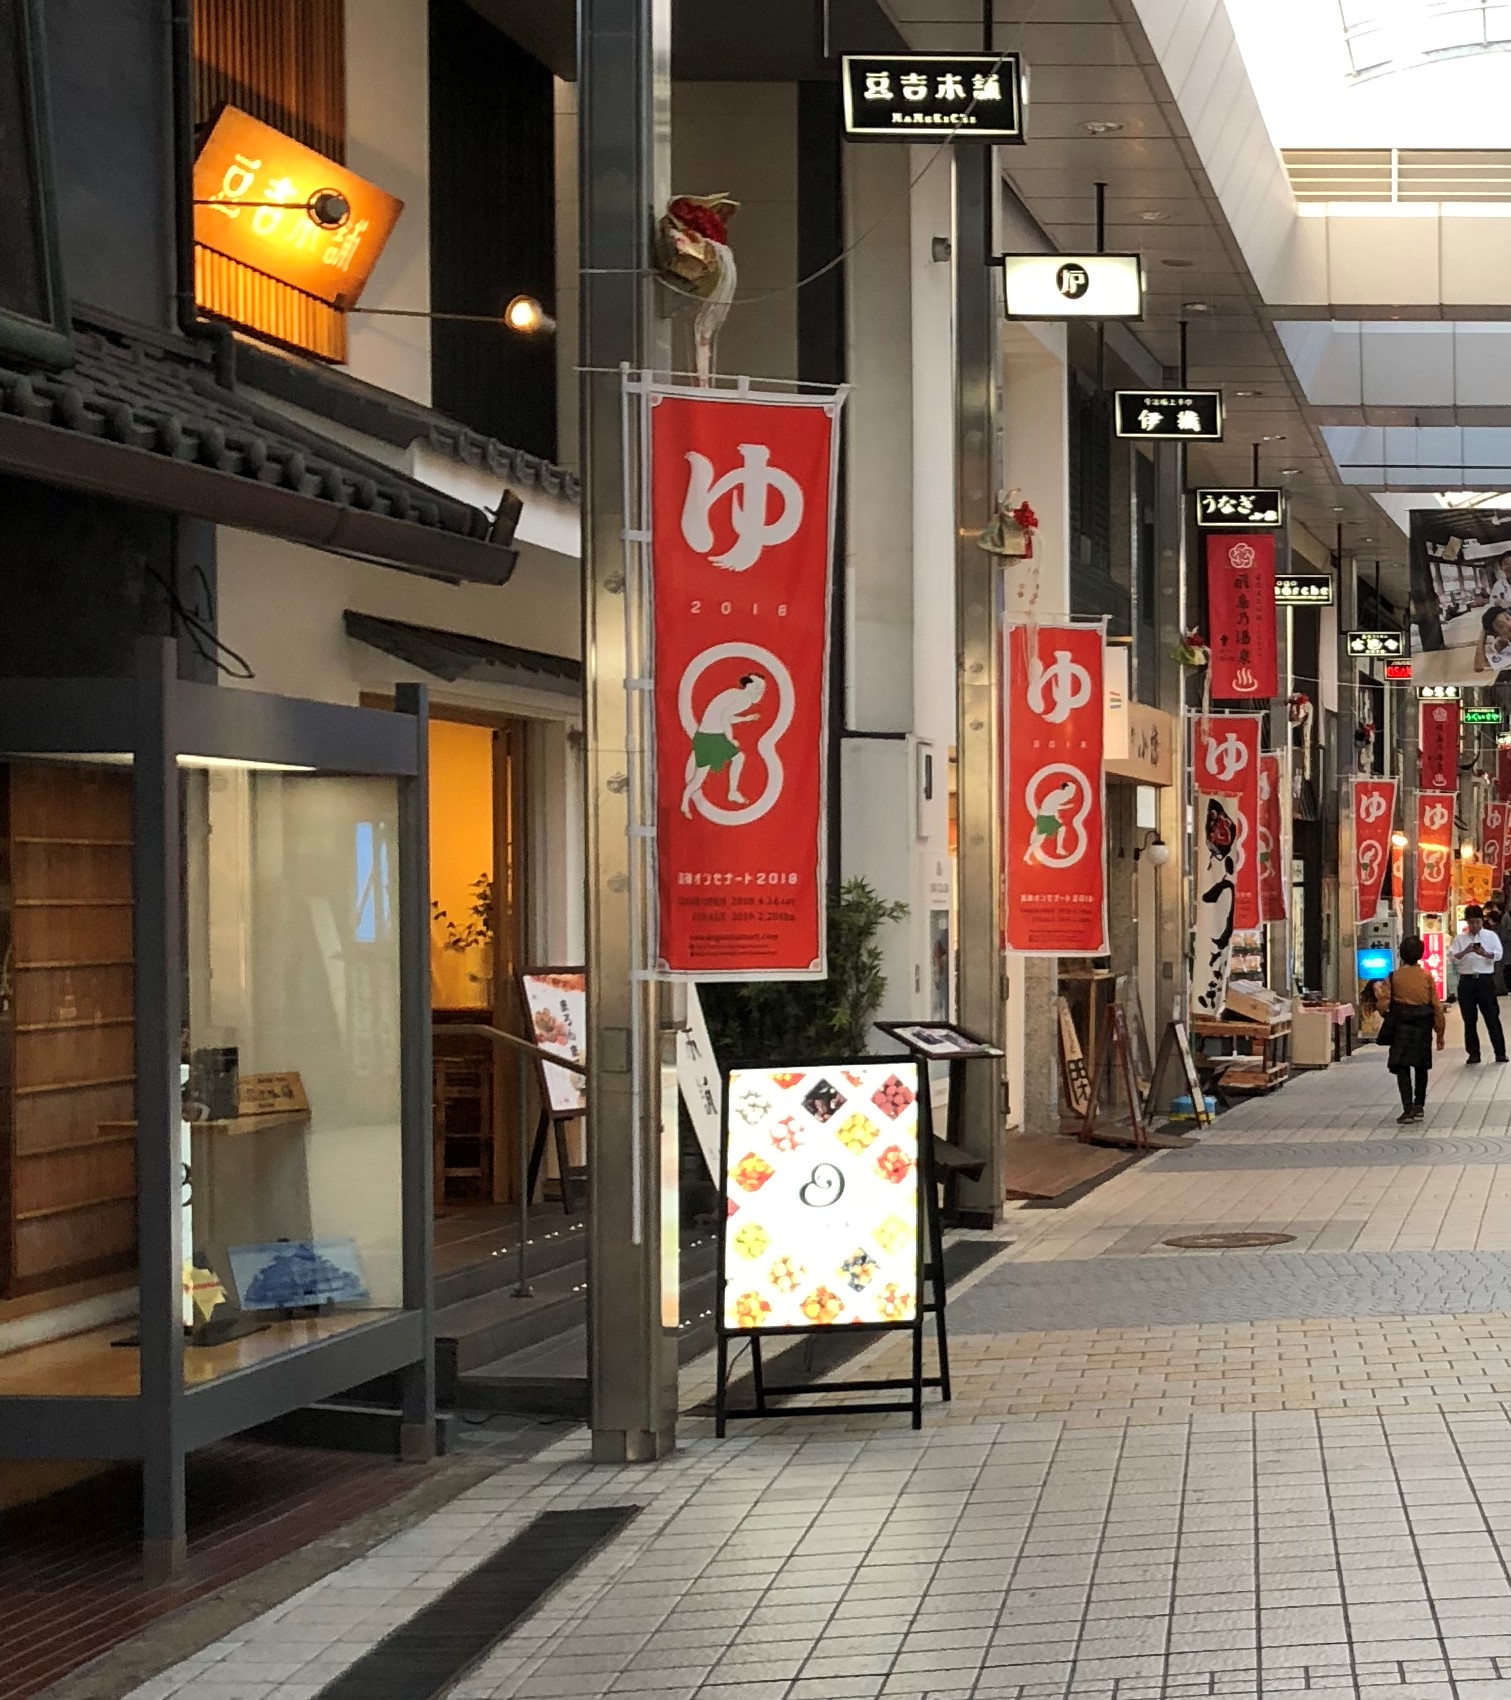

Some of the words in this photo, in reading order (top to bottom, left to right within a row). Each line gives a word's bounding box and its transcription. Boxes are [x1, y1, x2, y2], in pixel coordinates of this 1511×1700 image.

[863, 70, 1001, 101] 豆吉本舗
[681, 443, 804, 572] ゆ
[1202, 494, 1256, 515] うなぎ
[1027, 650, 1092, 724] ゆ
[1205, 732, 1249, 781] ゆ
[1360, 791, 1386, 823] ゆ
[1424, 803, 1449, 830] ゆ
